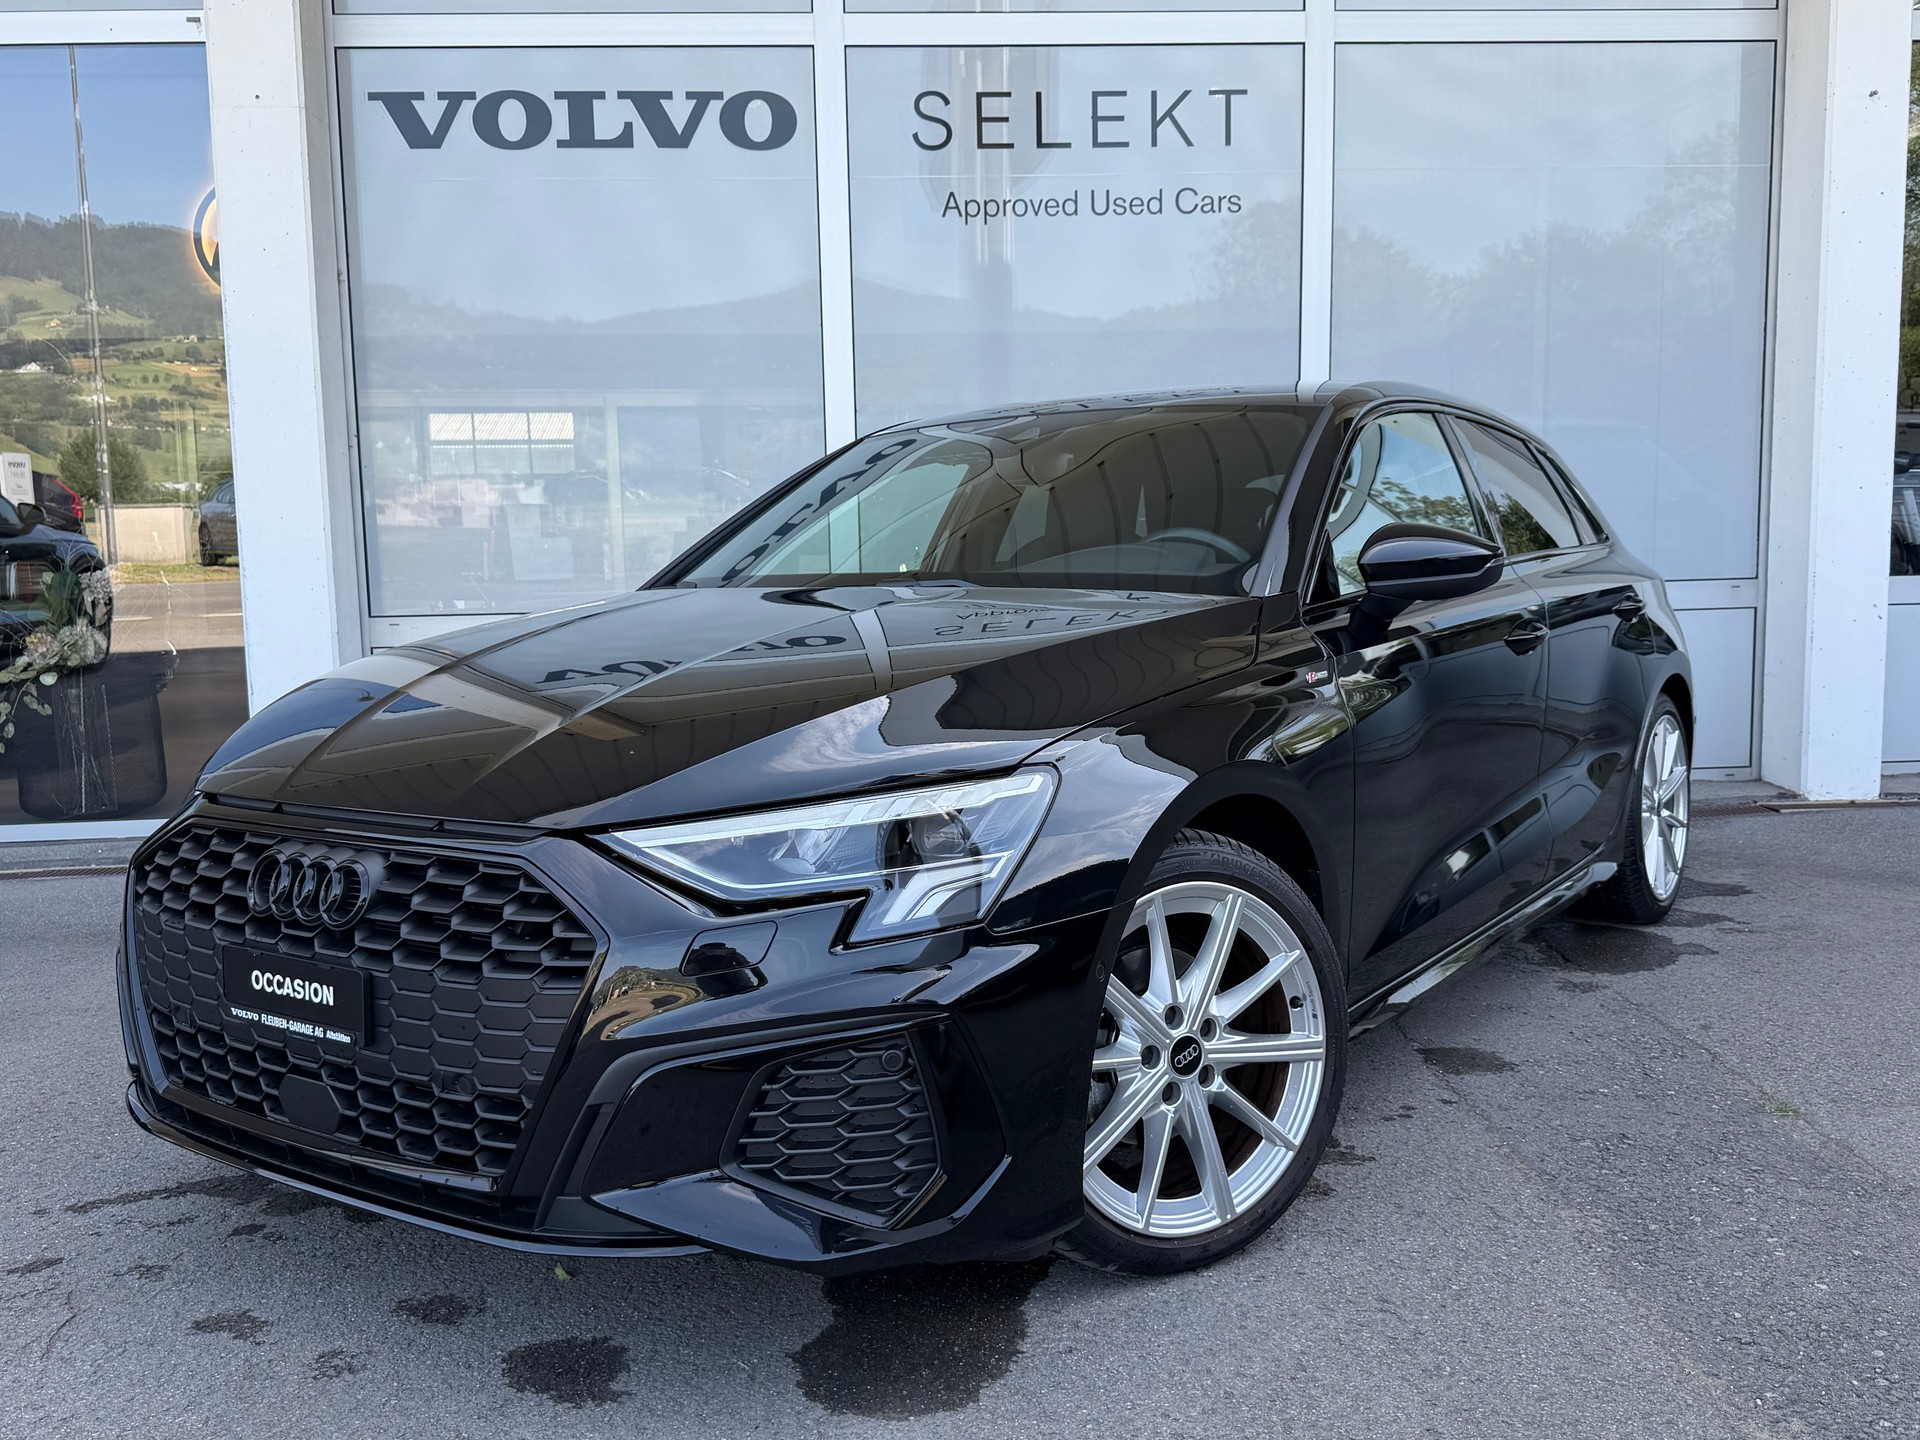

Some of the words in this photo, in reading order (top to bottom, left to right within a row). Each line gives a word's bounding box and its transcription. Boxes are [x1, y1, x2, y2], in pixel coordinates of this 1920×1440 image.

[368, 90, 797, 150] VOLVO
[912, 89, 1248, 151] SELEKT
[942, 189, 1079, 225] Approved
[1090, 189, 1163, 216] Used
[1174, 187, 1242, 215] Cars
[251, 969, 334, 1006] OCCASION
[230, 1007, 259, 1021] VOLVO
[261, 1013, 314, 1036] FLEUBEN-GARAGE
[314, 1026, 324, 1038] AG
